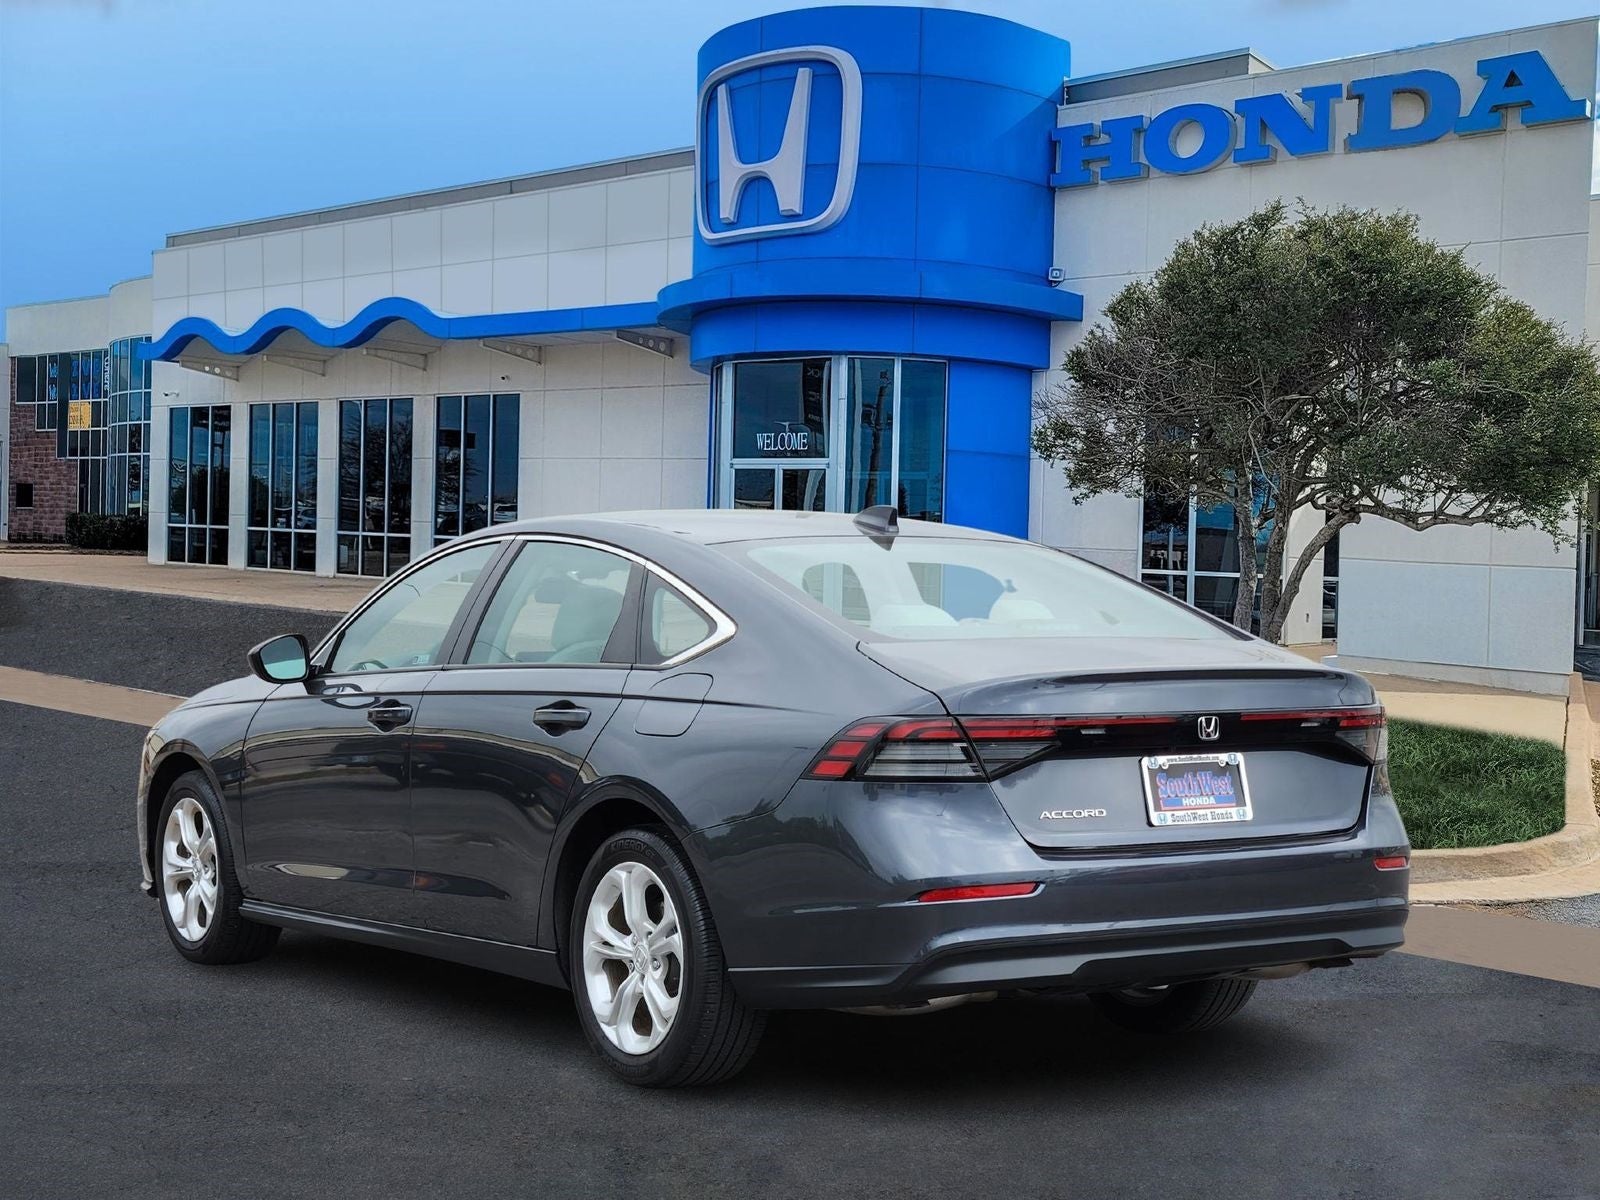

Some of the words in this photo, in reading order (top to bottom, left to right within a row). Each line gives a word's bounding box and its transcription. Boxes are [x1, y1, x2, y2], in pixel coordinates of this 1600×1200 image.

[1050, 50, 1591, 187] HONDA
[756, 432, 808, 451] WELCOME
[1157, 771, 1234, 798] SouthWest
[1182, 796, 1217, 807] HONDA
[1039, 808, 1107, 820] ACCORD
[1171, 811, 1209, 823] SouthWest
[1209, 810, 1234, 821] Honda
